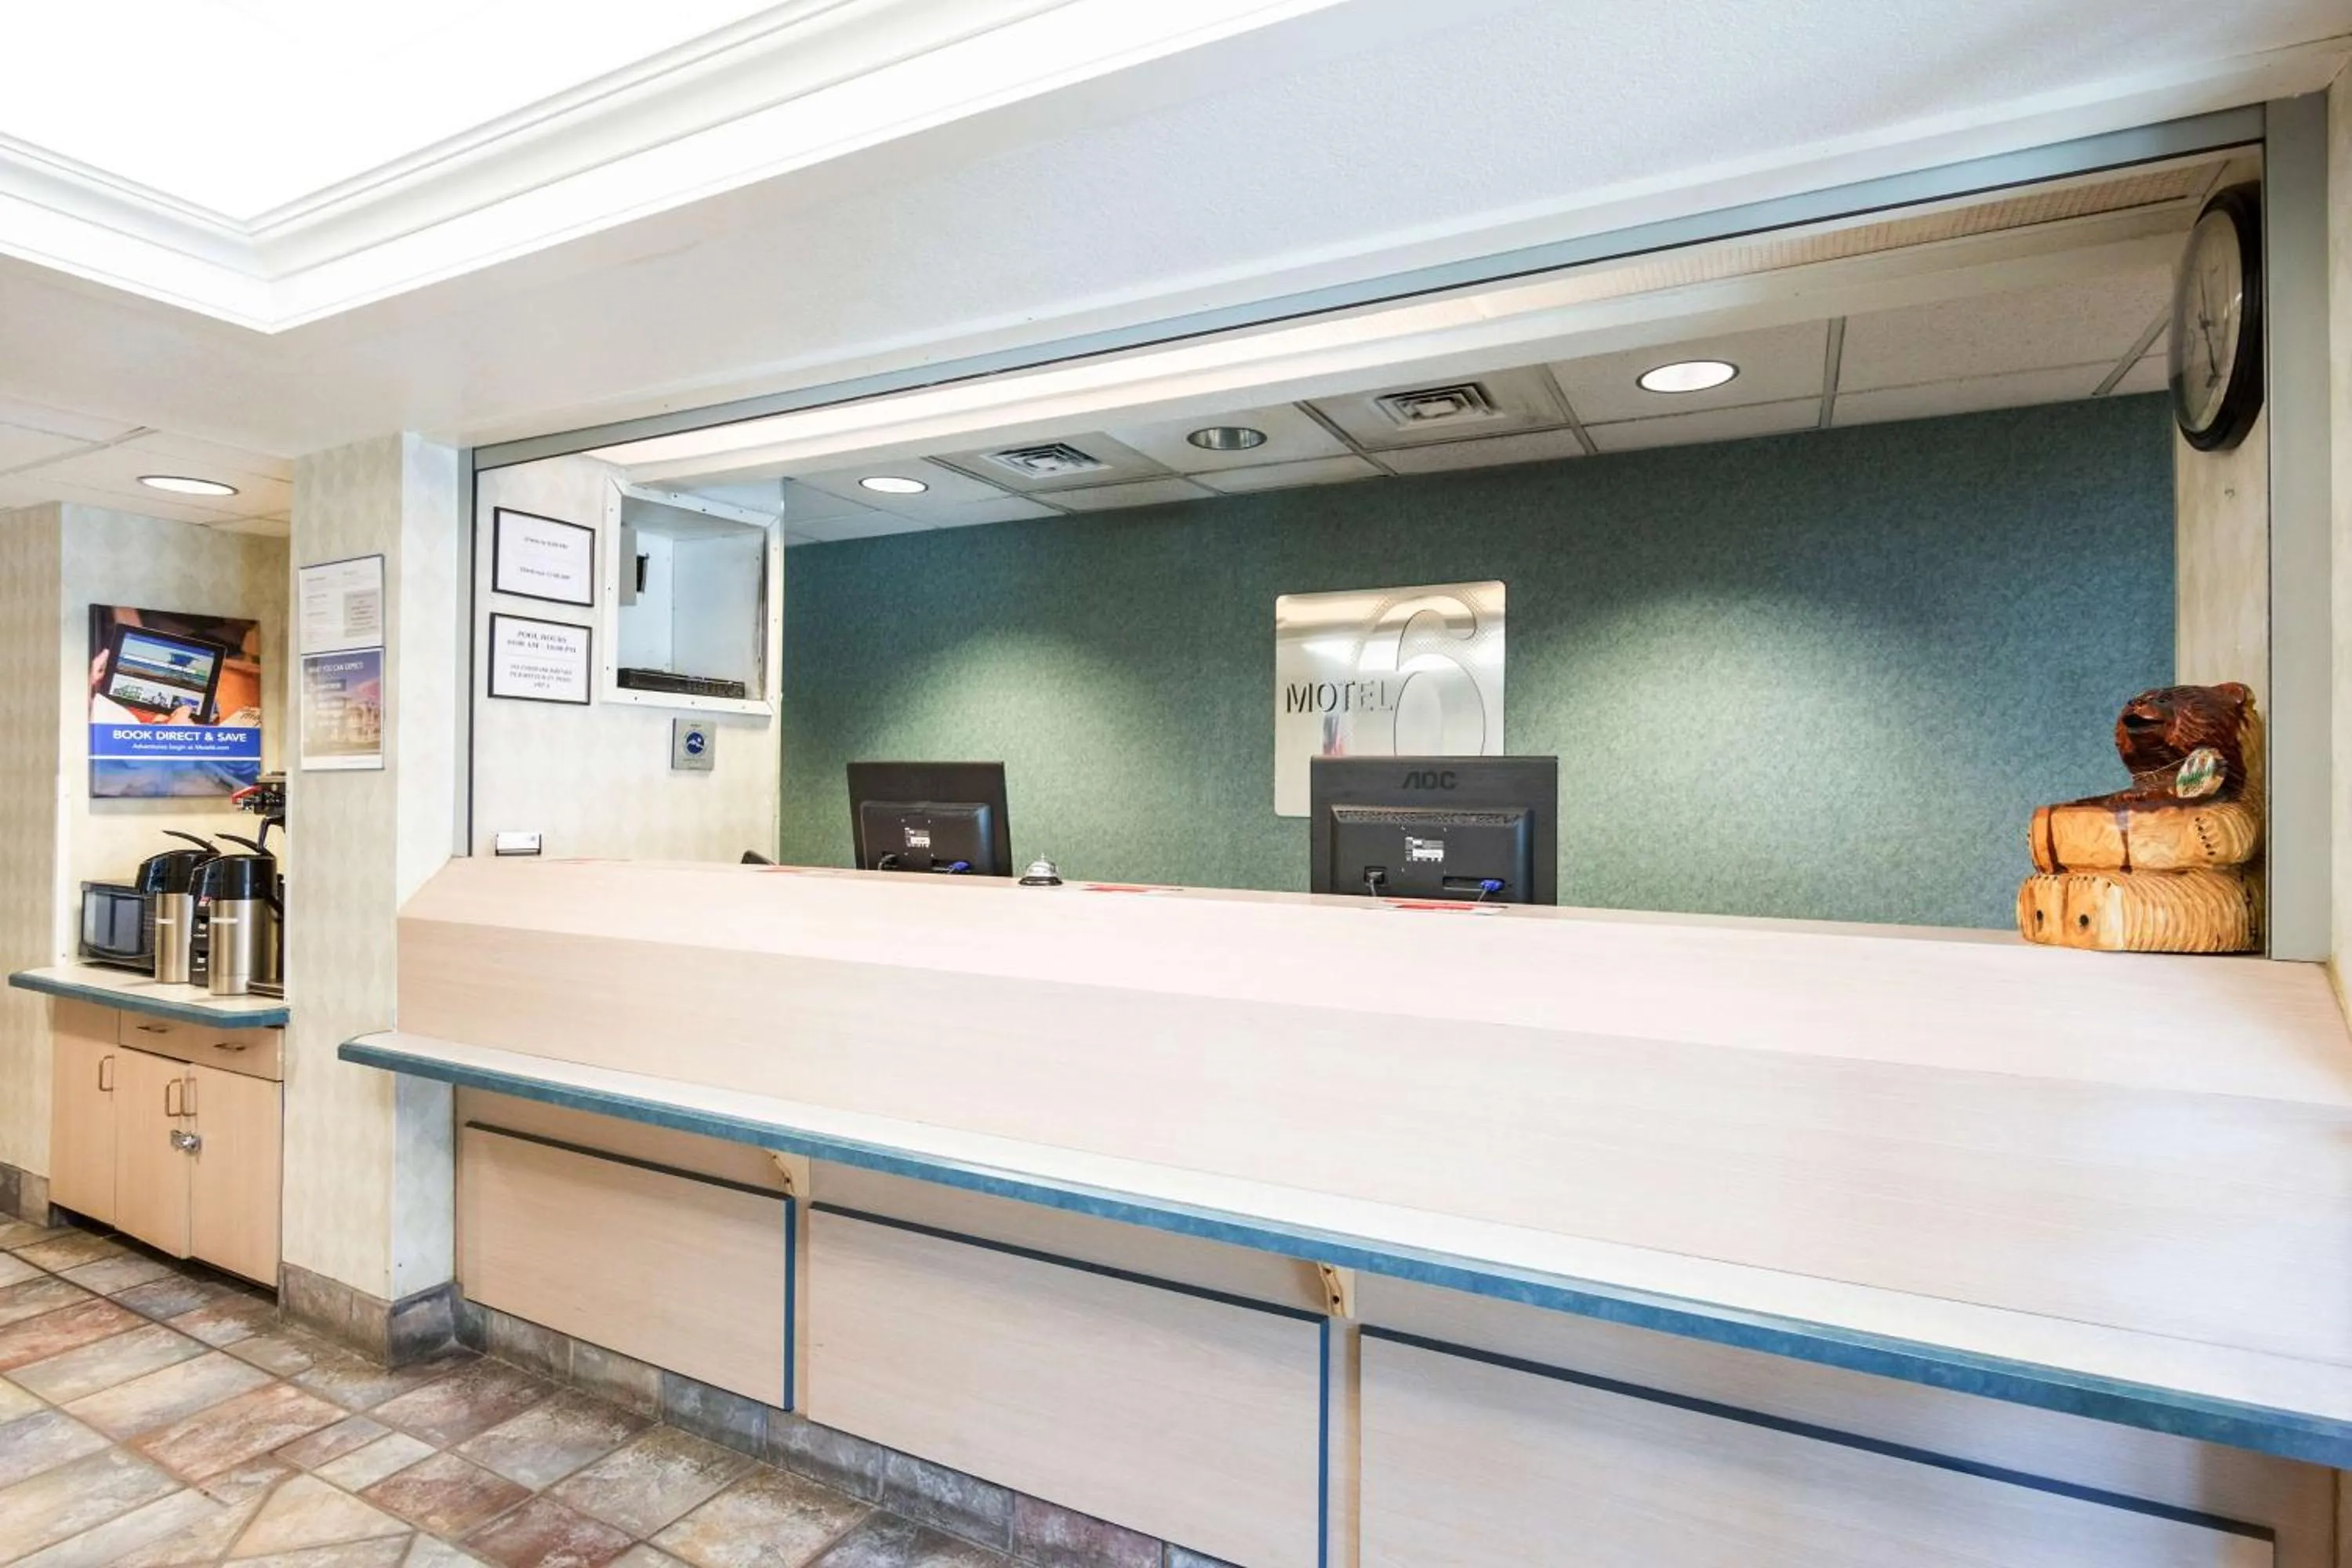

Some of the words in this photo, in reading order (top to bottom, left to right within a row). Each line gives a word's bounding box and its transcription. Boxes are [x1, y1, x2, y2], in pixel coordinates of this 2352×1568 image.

[1286, 680, 1394, 714] MOTEL
[112, 729, 152, 741] BOOK
[156, 731, 201, 742] DIRECT
[204, 732, 214, 742] &
[217, 732, 248, 742] SAVE
[1402, 770, 1459, 790] AOC
